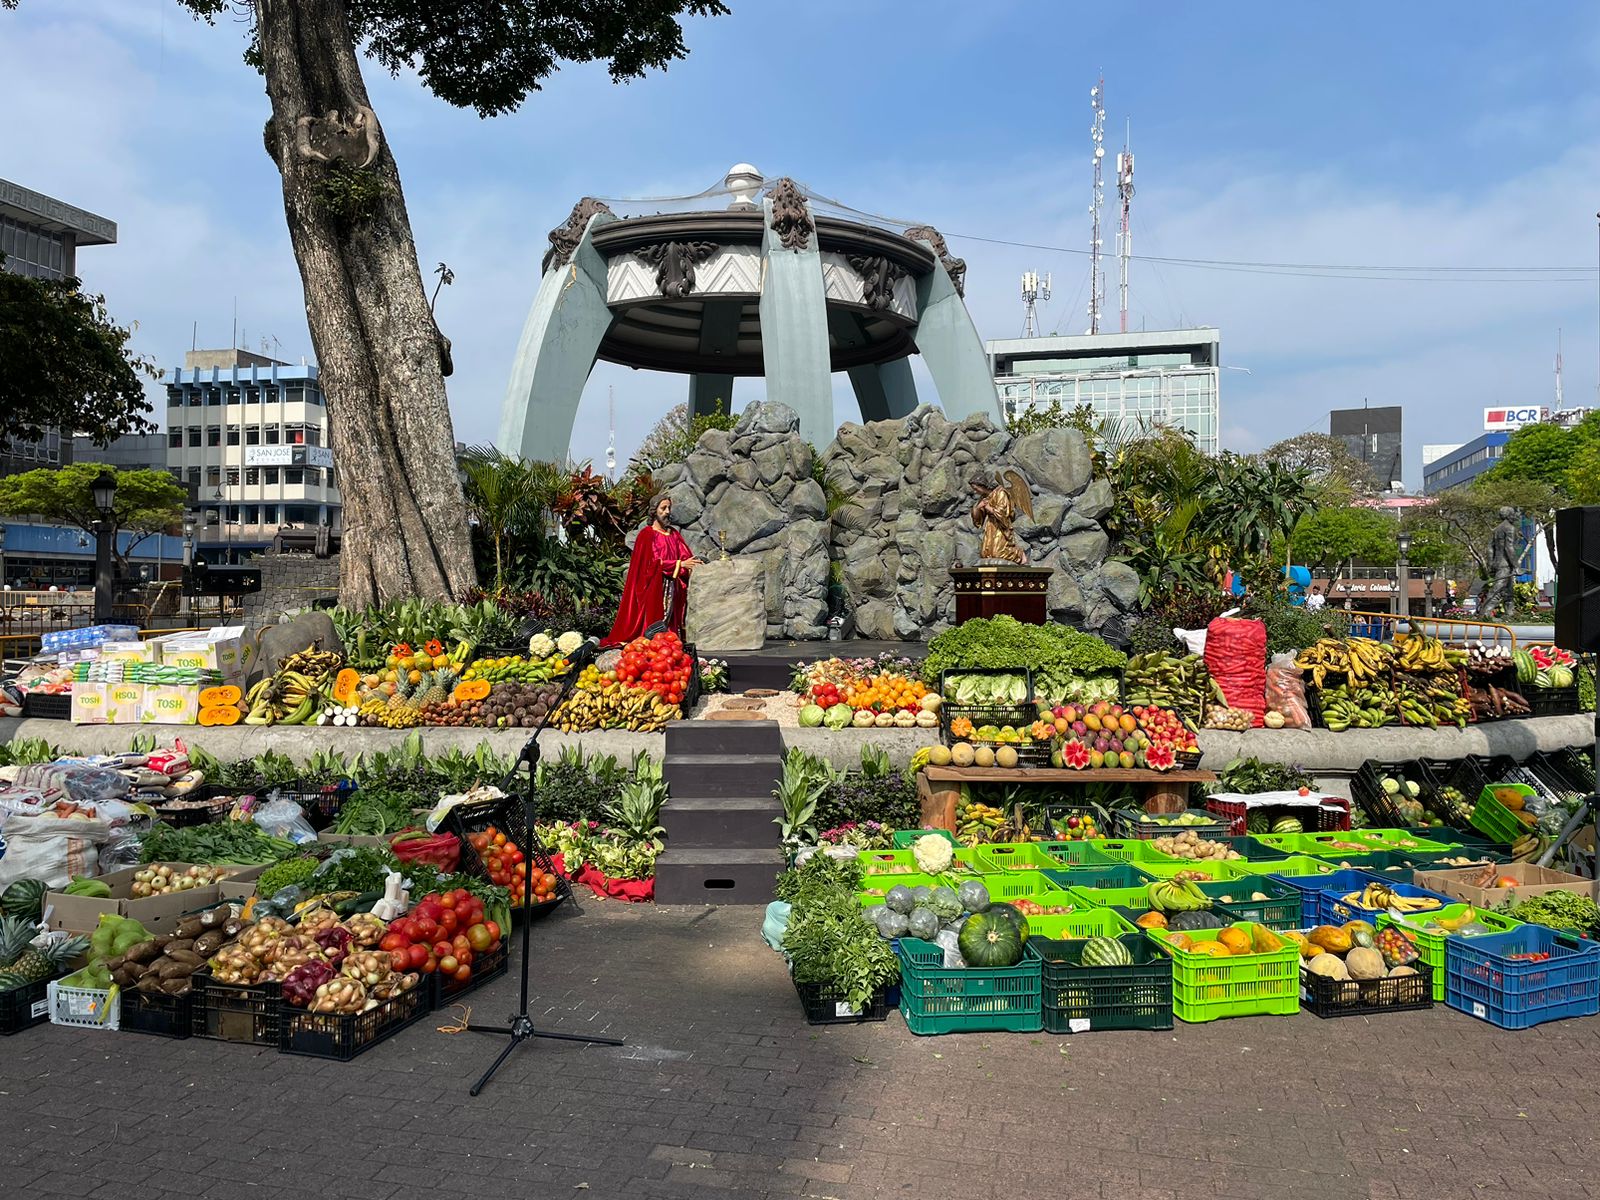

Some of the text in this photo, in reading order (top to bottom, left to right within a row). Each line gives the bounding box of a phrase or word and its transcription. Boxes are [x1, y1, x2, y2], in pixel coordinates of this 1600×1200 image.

[1506, 409, 1538, 422] BCR
[256, 448, 273, 457] SAN
[222, 651, 235, 662] TOSH
[177, 658, 203, 668] TOSH
[80, 696, 100, 704] TOSH
[115, 691, 138, 700] TOSH
[157, 699, 183, 709] TOSH
